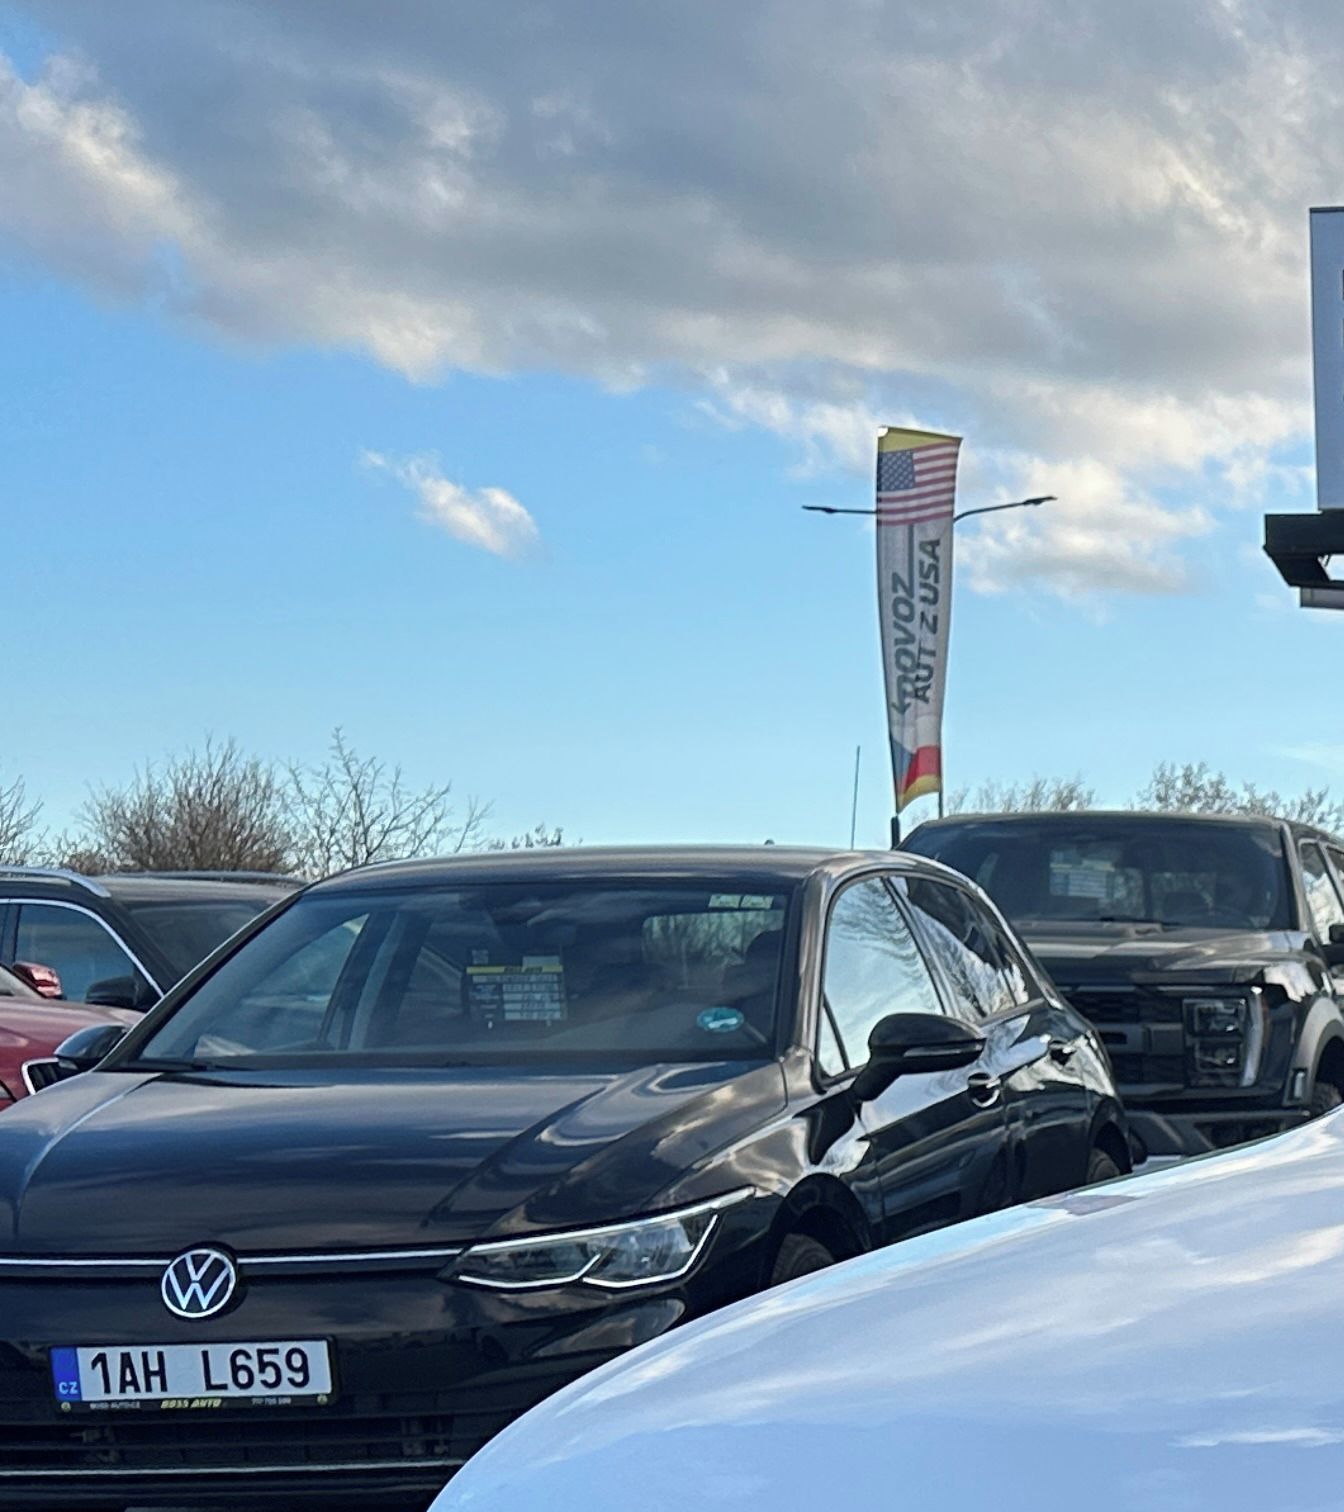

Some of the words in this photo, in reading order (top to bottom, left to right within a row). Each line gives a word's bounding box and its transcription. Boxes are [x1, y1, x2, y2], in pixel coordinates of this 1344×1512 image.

[918, 538, 941, 606] USA
[891, 571, 918, 700] DOVOZ
[920, 610, 939, 635] Z
[914, 640, 938, 703] AUT
[58, 1381, 79, 1395] CZ
[91, 1351, 168, 1394] 1AH
[201, 1347, 310, 1391] L659
